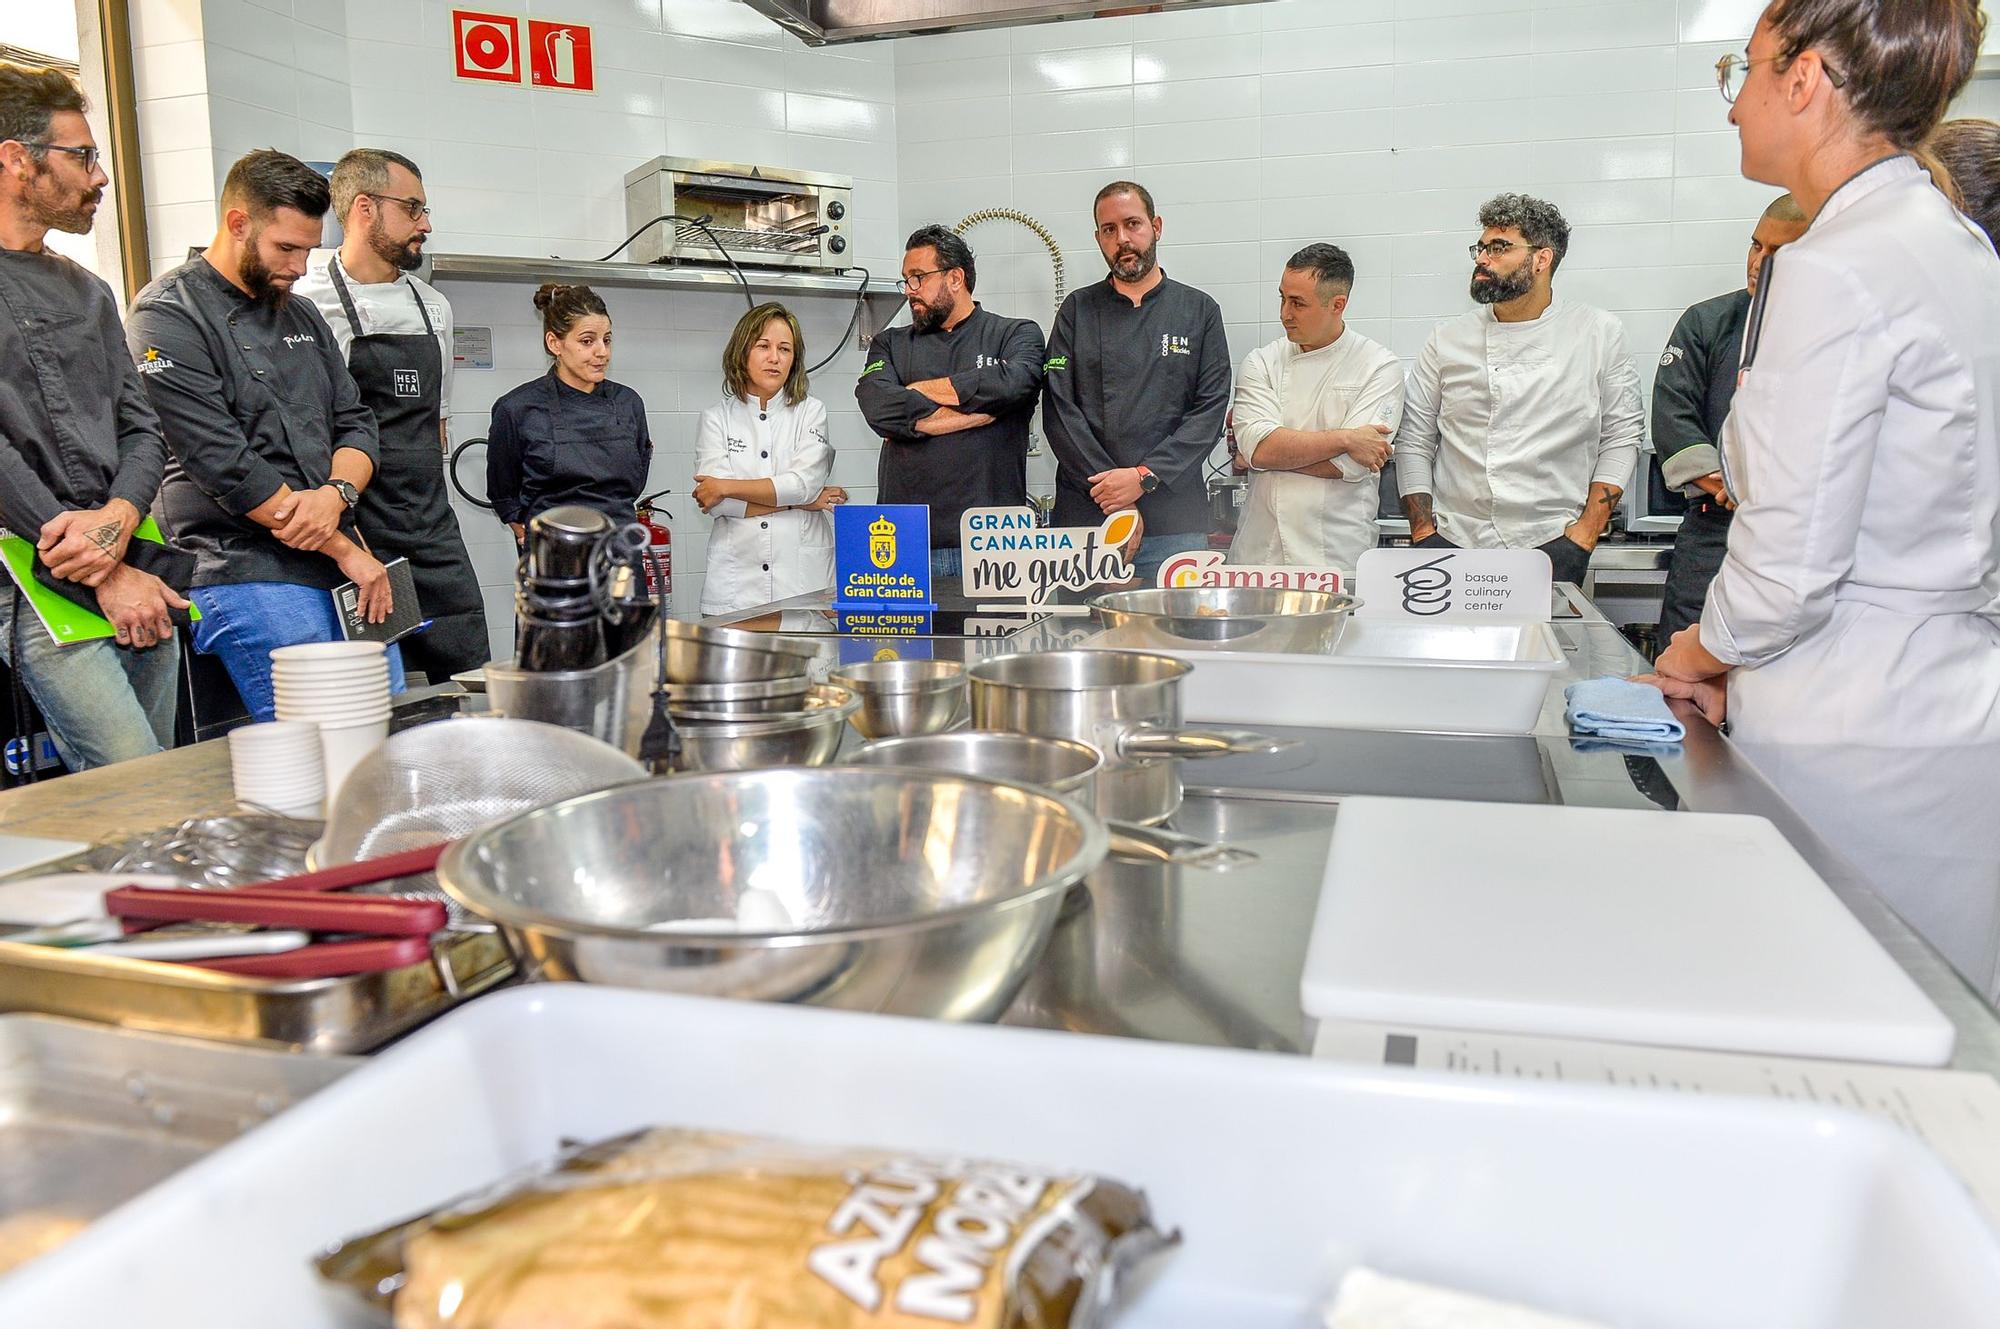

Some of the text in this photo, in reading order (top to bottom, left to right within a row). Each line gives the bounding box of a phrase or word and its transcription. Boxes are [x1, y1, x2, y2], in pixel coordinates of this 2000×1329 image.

[1172, 336, 1188, 346] EN
[397, 375, 417, 383] HES
[398, 384, 417, 393] TIA
[969, 514, 1031, 530] GRAN
[970, 534, 1073, 551] CANARIA
[973, 531, 1132, 605] me gusta
[849, 573, 915, 586] Cabildo de
[1164, 557, 1338, 593] Cámara
[1465, 572, 1508, 585] basque
[844, 586, 924, 599] Gran Canaria
[1465, 586, 1511, 599] culinary
[1464, 600, 1503, 611] center
